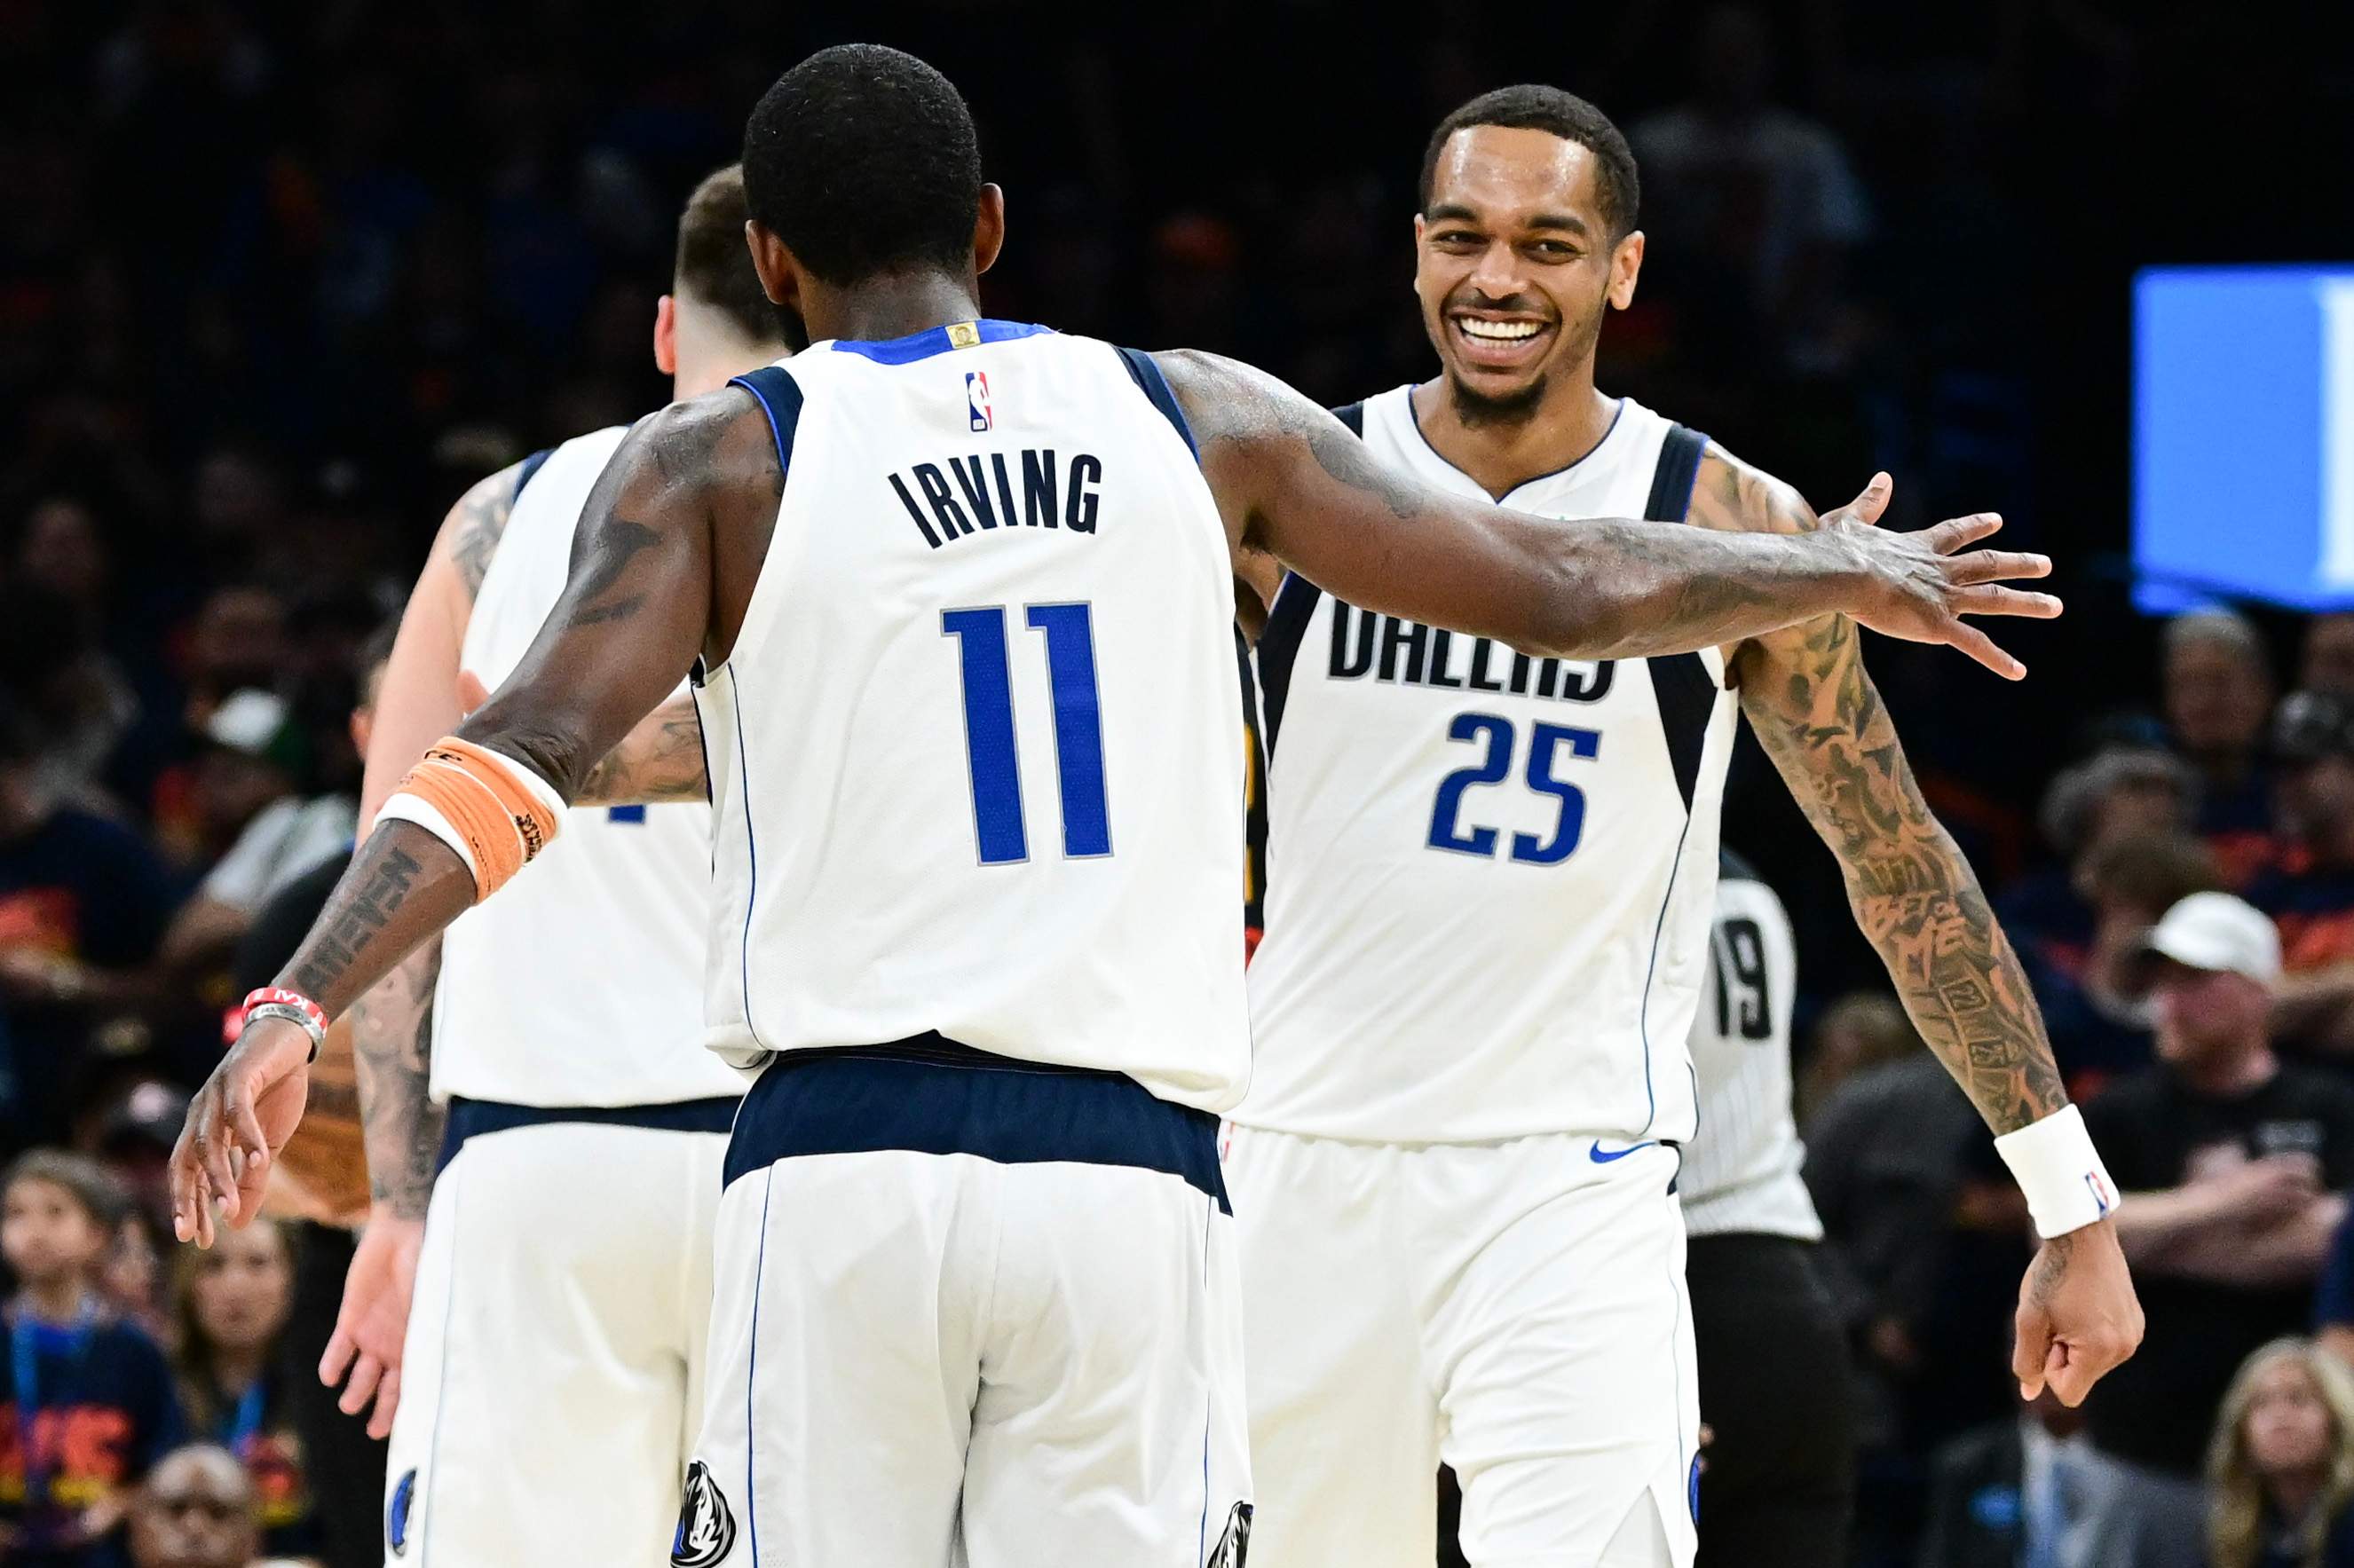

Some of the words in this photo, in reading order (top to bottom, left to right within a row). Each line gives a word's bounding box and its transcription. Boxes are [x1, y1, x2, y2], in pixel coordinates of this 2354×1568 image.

[888, 448, 1102, 549] IRVING
[939, 601, 1115, 867] 11
[1424, 710, 1603, 867] 25
[1710, 919, 1772, 1038] 19
